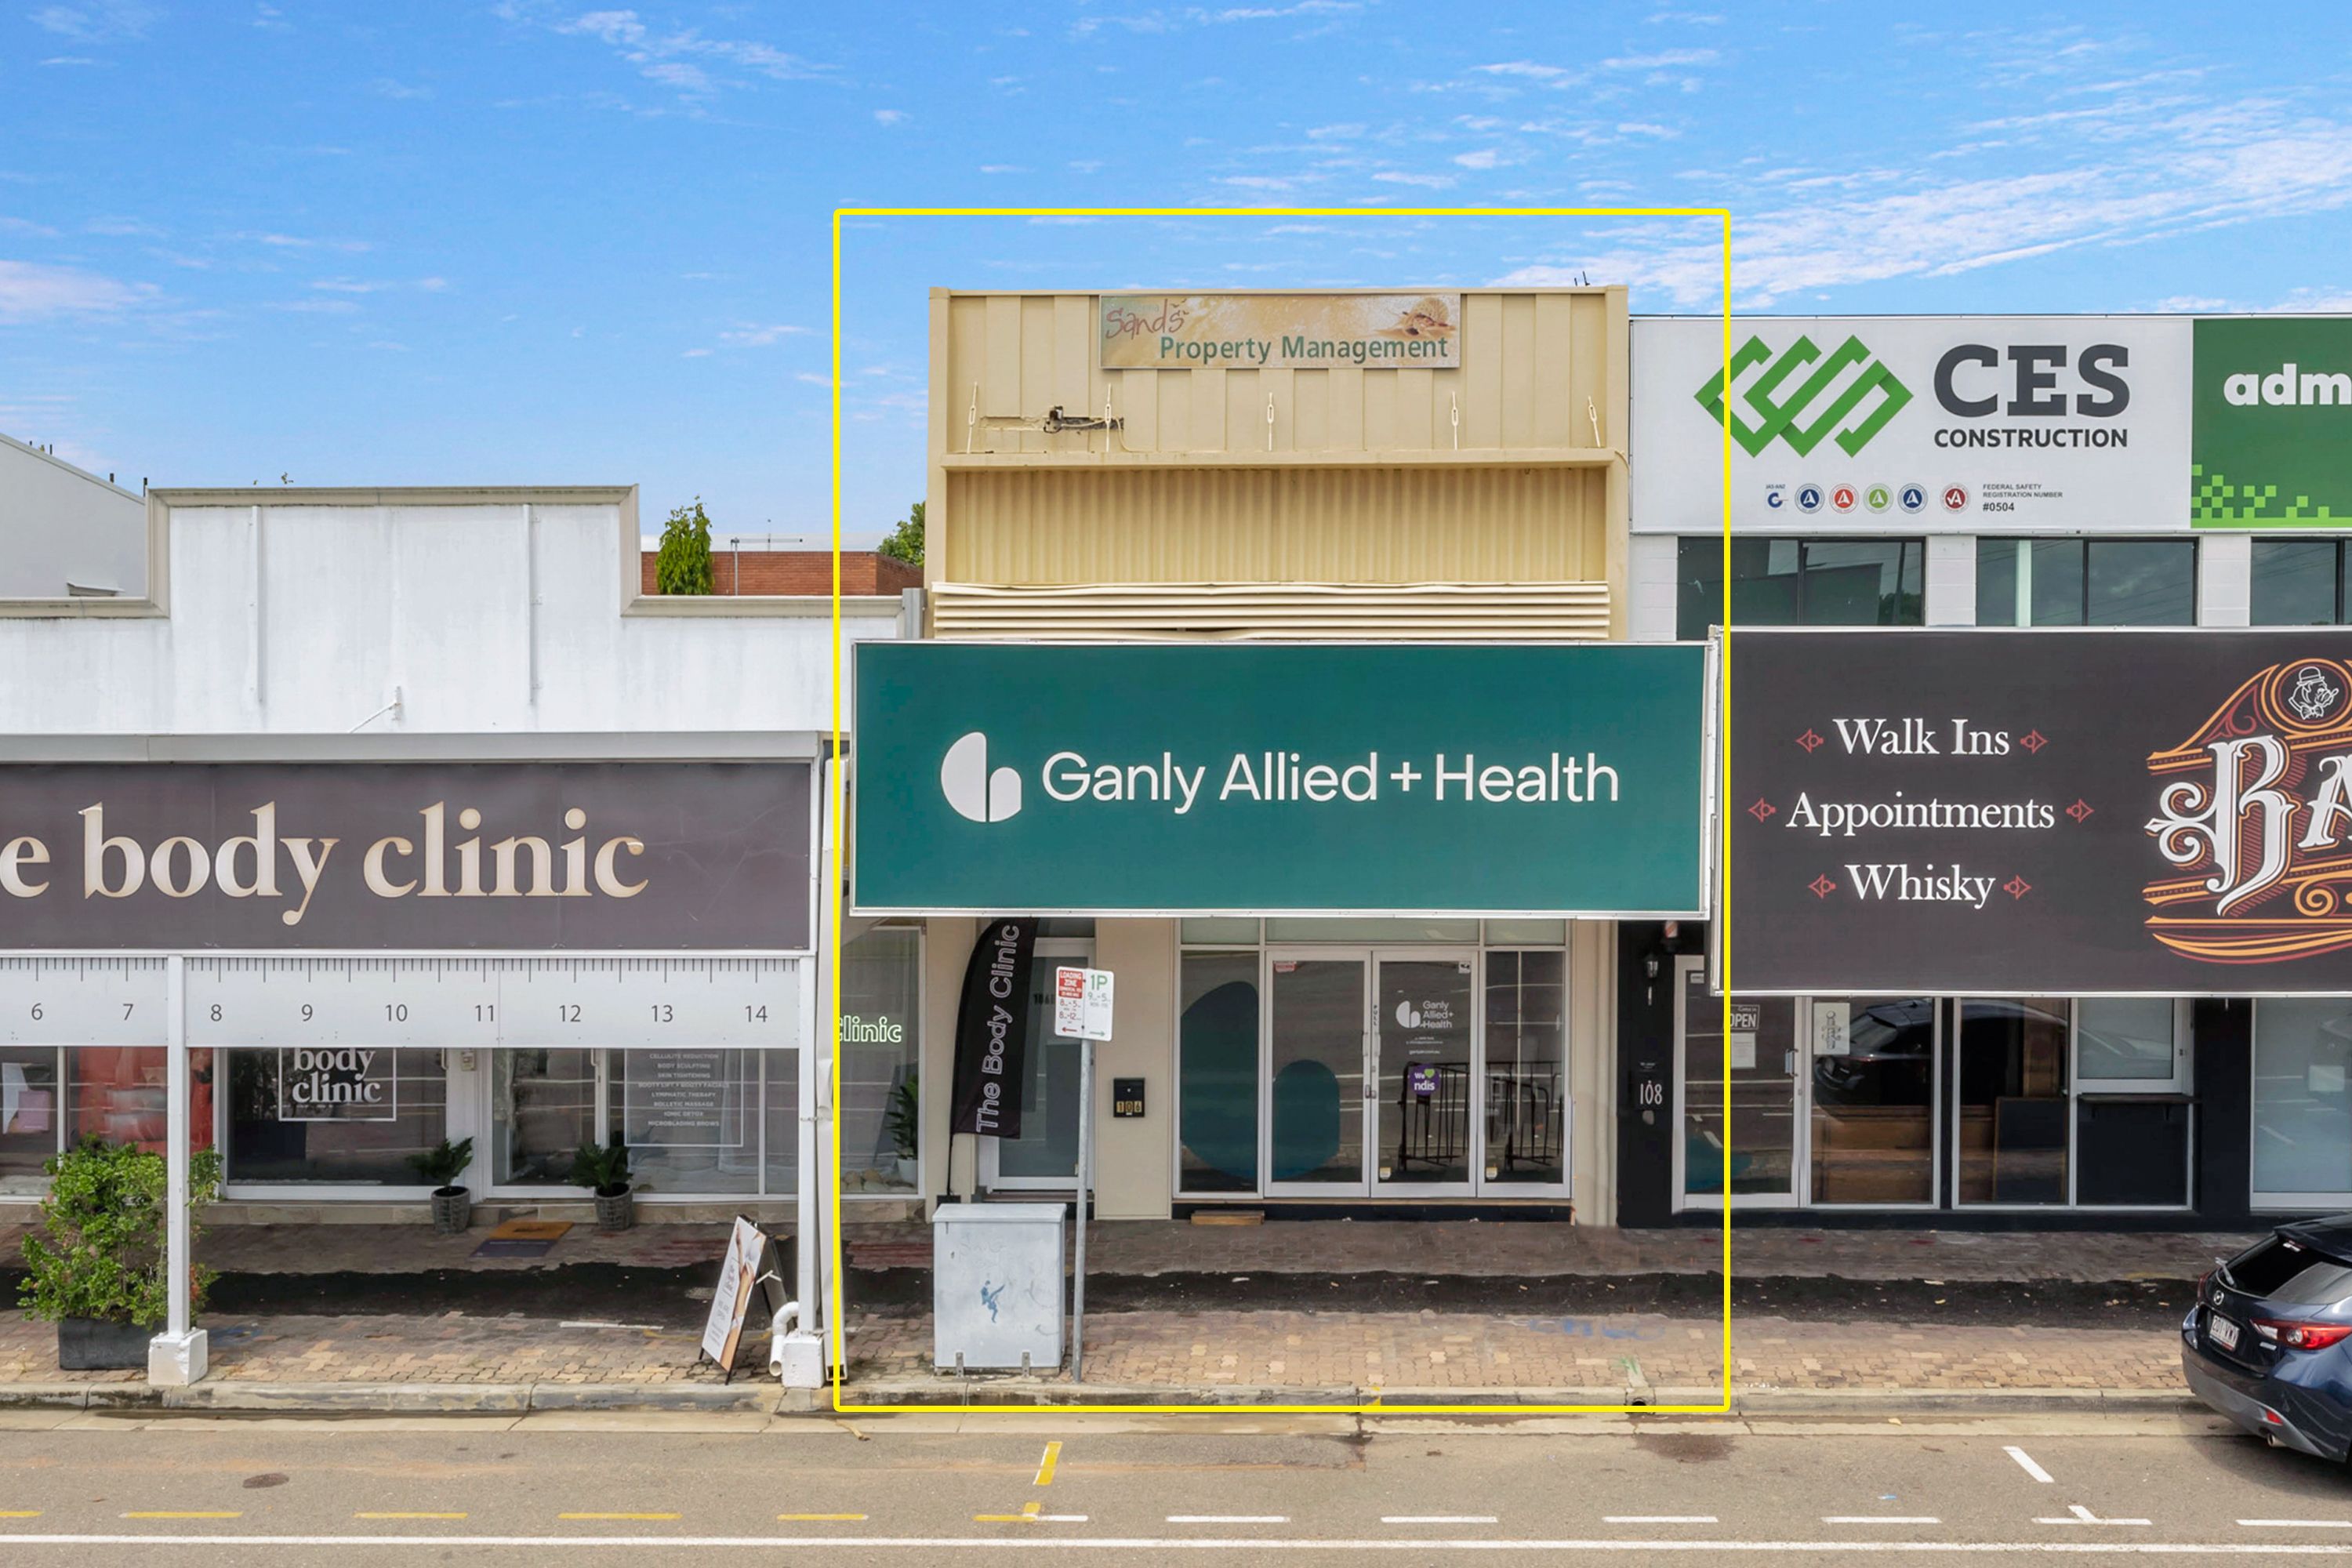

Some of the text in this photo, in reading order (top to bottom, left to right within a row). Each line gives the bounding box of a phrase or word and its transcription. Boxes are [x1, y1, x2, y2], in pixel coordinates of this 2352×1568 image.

[1160, 336, 1449, 365] Property Management
[1933, 343, 2130, 418] CES
[2223, 363, 2352, 406] adm
[1934, 428, 2129, 448] CONSTRUCTION
[1982, 502, 2016, 512] #0504
[1832, 717, 2010, 756] Walk Ins
[1042, 751, 1619, 815] Ganly Allied + Health
[1785, 790, 2055, 837] Appointments
[78, 800, 339, 926] body
[363, 800, 649, 898] clinic
[1844, 863, 1996, 909] Whisky
[1091, 975, 1108, 990] 1P
[31, 1003, 768, 1023] 6 7 8 9 10 11 12 13 14
[1422, 1000, 1450, 1011] Ganly
[1422, 1011, 1448, 1019] Allied
[840, 1015, 902, 1043] linic
[975, 924, 1020, 1133] The Body Clinic
[1423, 1020, 1453, 1029] Health
[294, 1047, 376, 1082] body
[292, 1071, 383, 1103] clinic
[1414, 1080, 1436, 1091] ndis
[1640, 1083, 1663, 1105] 108
